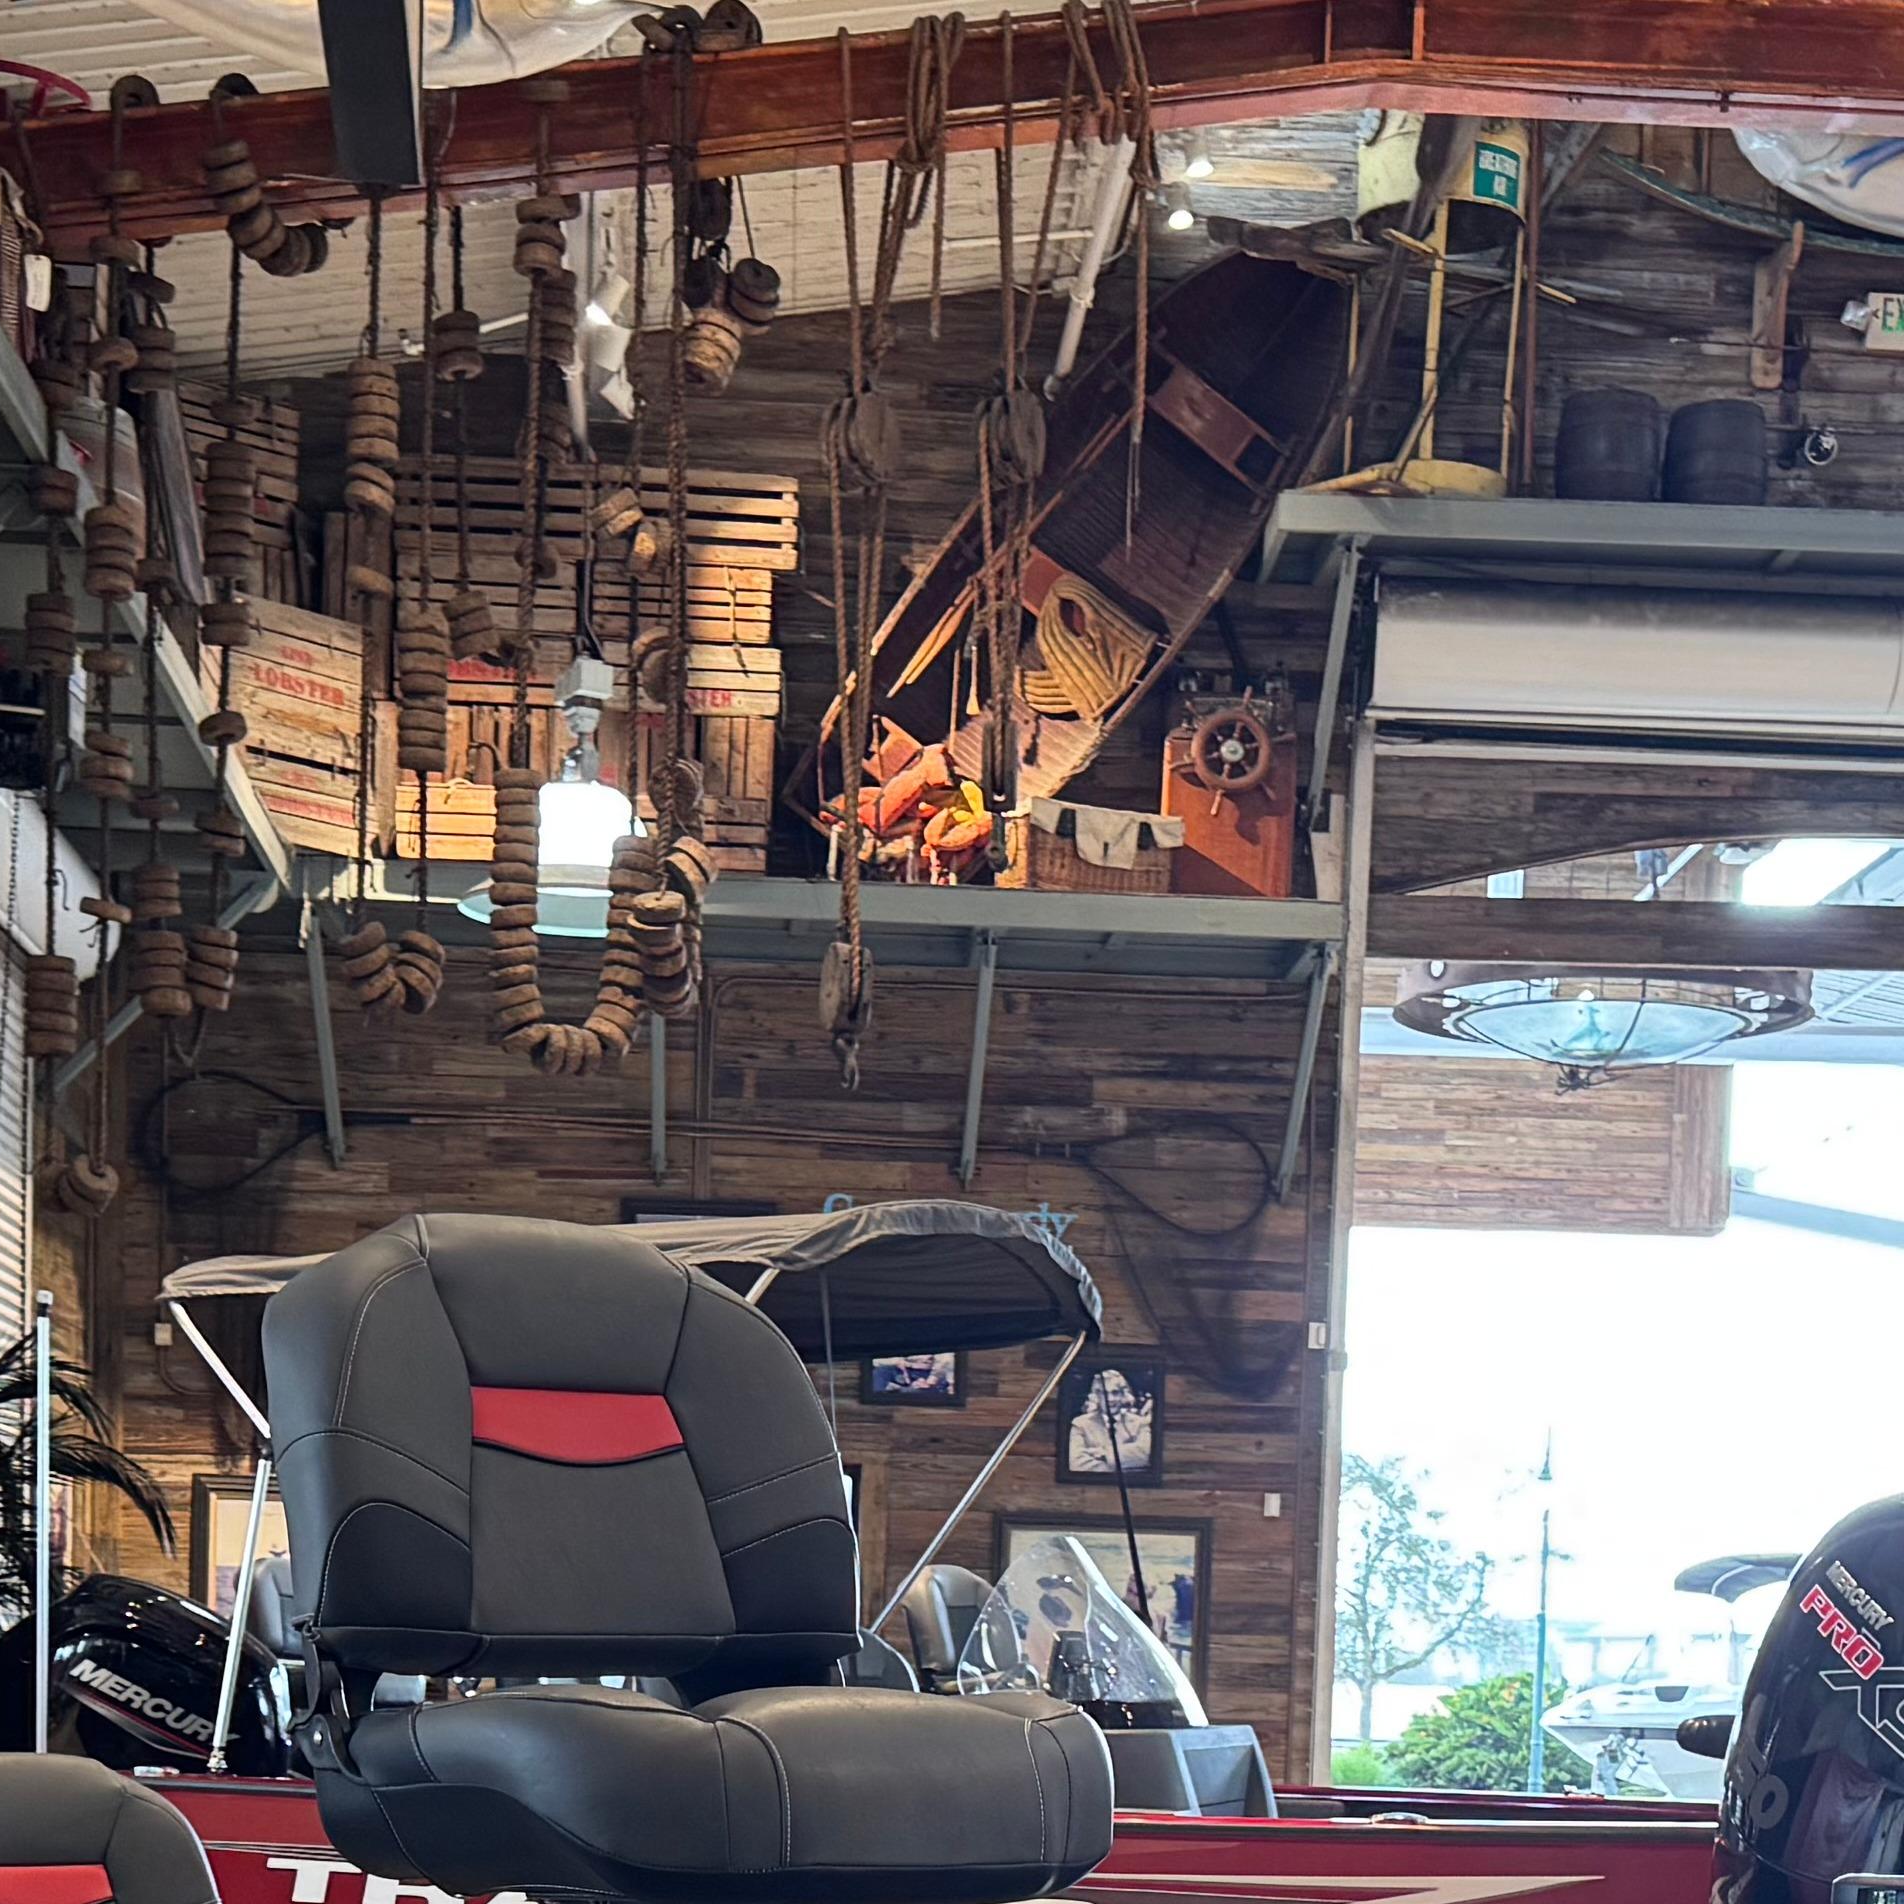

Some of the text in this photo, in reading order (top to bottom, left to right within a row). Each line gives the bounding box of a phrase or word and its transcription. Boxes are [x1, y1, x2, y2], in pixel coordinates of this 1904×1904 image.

[249, 663, 344, 705] LOBSTER
[1799, 1584, 1885, 1680] PRO
[1825, 1561, 1895, 1633] MERCURY
